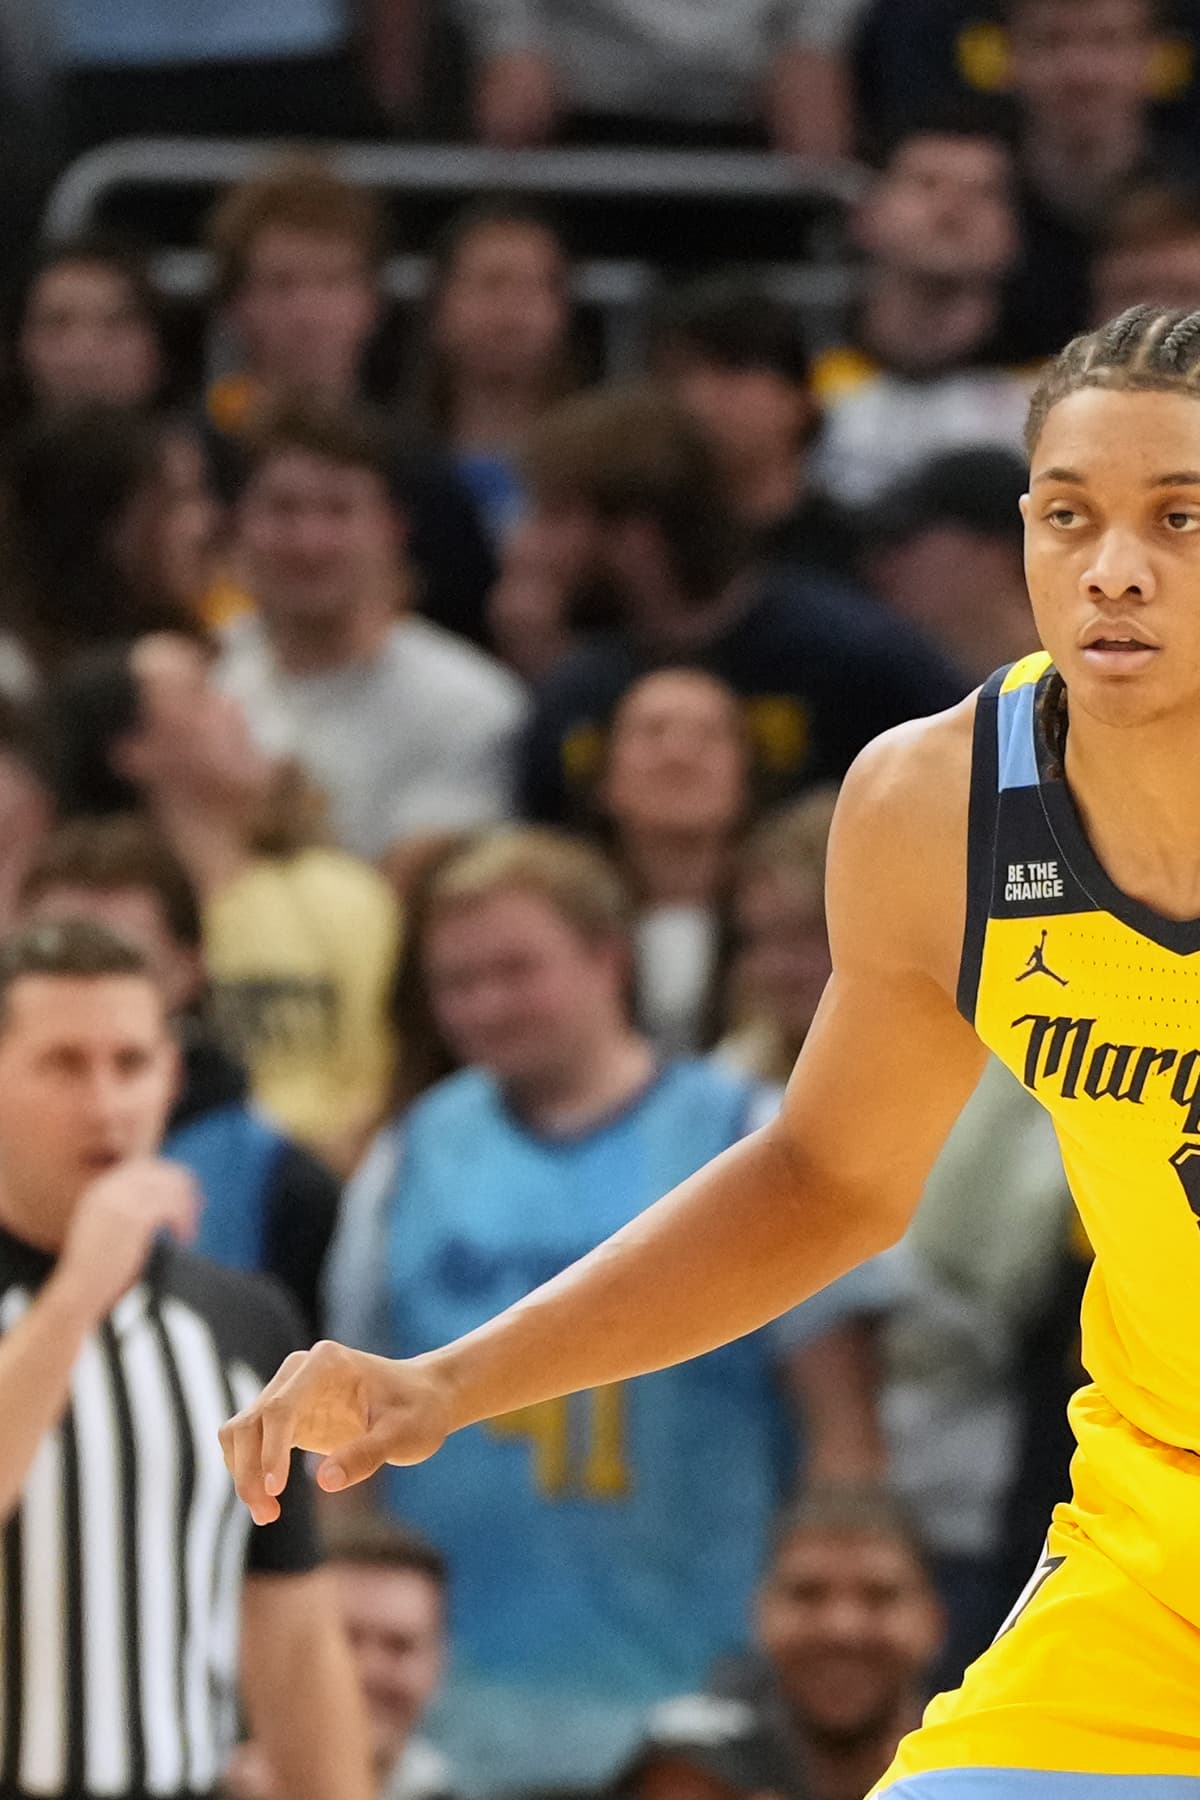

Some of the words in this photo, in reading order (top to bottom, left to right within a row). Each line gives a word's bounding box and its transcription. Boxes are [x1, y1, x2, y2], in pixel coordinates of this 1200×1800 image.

[1008, 865, 1024, 882] BE
[1027, 862, 1058, 880] THE
[1005, 880, 1064, 901] CHANGE
